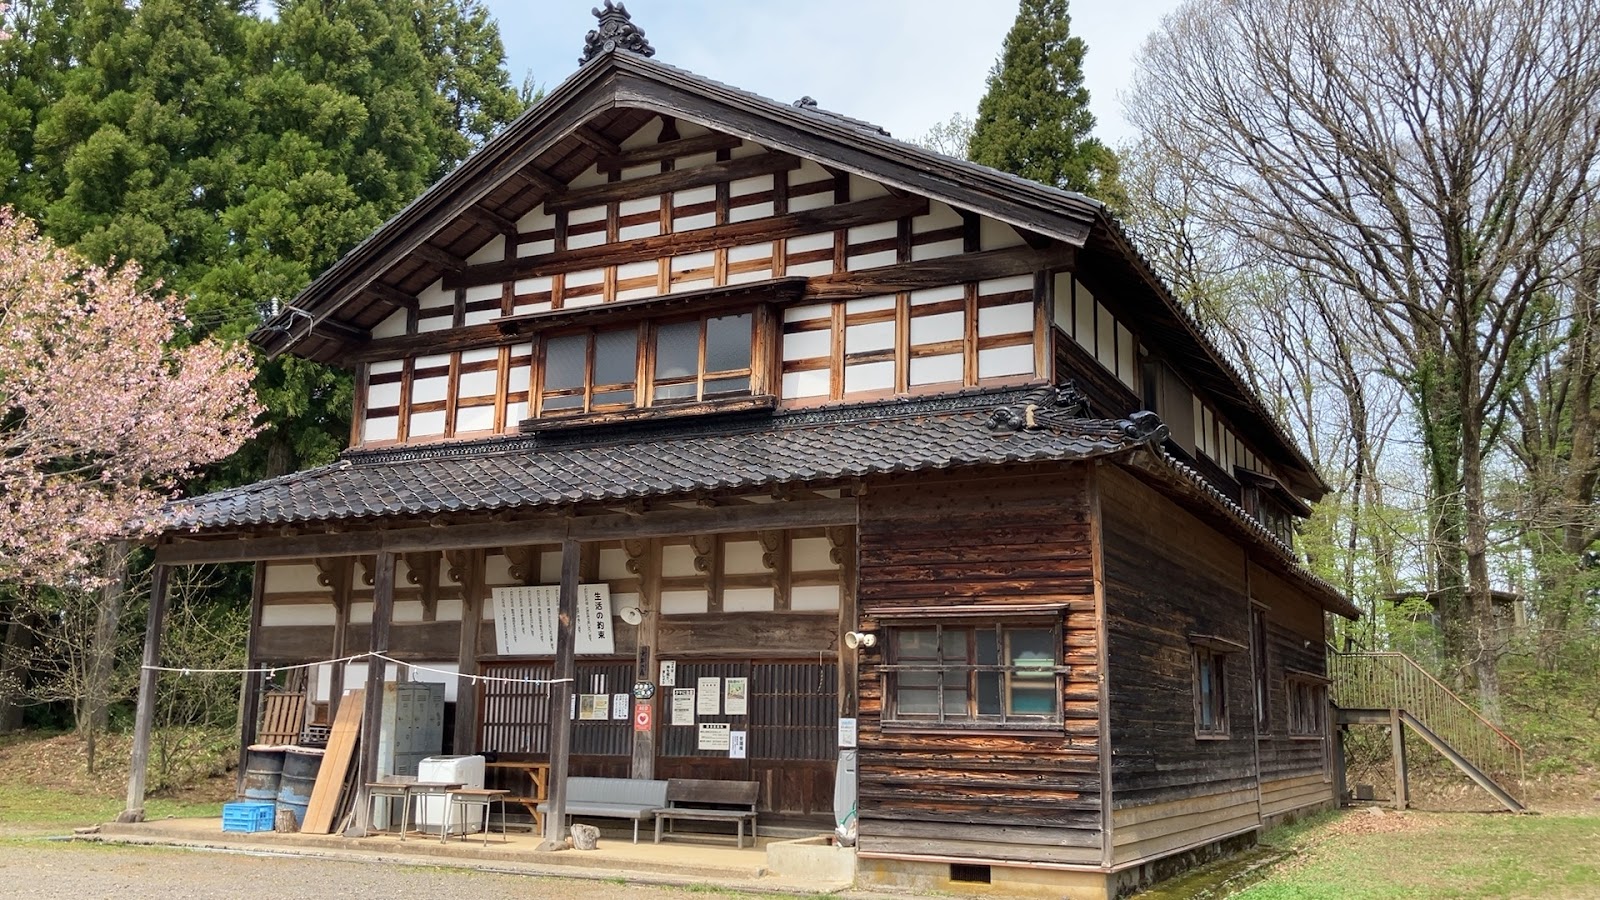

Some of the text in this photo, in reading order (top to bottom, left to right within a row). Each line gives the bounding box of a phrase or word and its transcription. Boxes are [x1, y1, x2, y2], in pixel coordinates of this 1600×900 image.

[594, 592, 605, 639] 生活の約束
